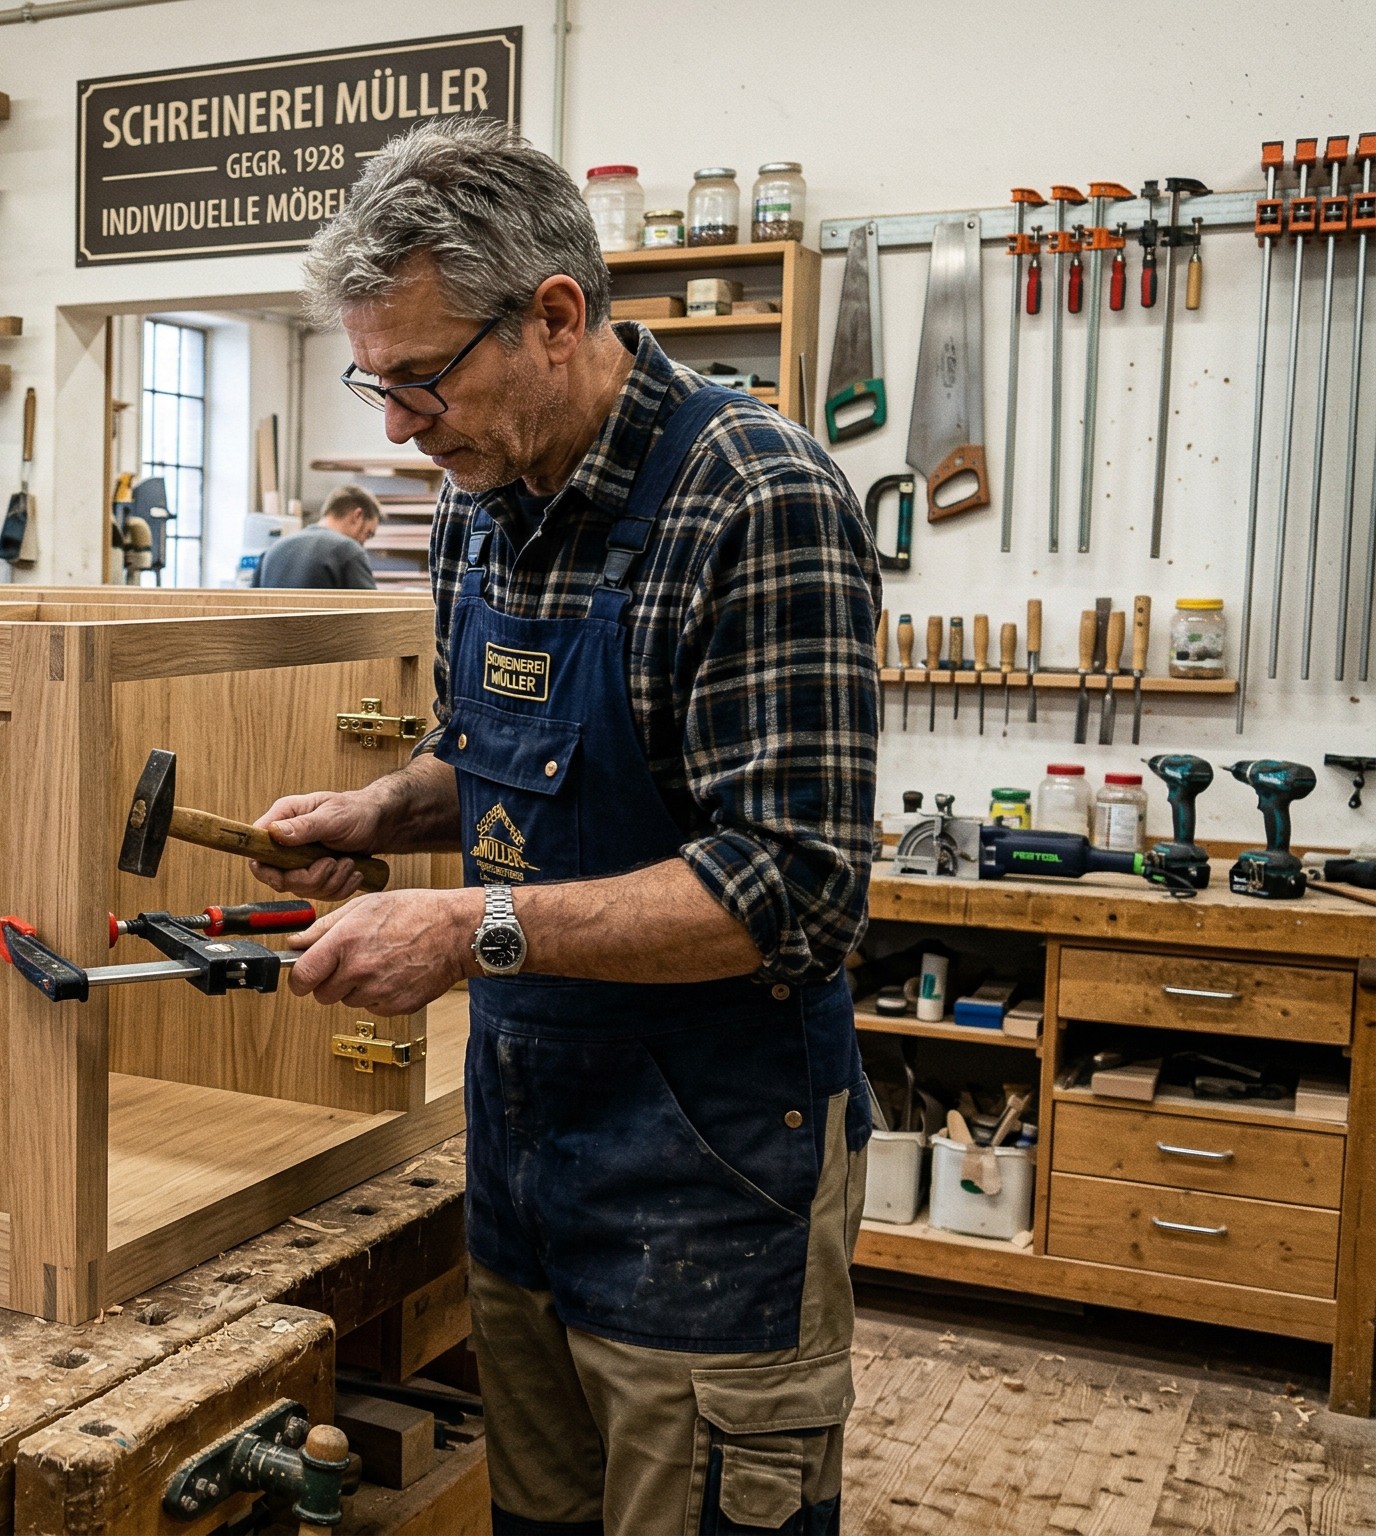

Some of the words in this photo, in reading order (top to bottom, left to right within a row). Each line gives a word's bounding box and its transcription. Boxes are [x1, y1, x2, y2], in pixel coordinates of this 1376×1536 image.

[102, 85, 323, 149] SCHREINEREI
[335, 67, 489, 125] MÜLLER
[226, 151, 287, 179] GEGR.
[294, 144, 345, 173] 1928
[102, 195, 260, 237] INDIVIDUELLE
